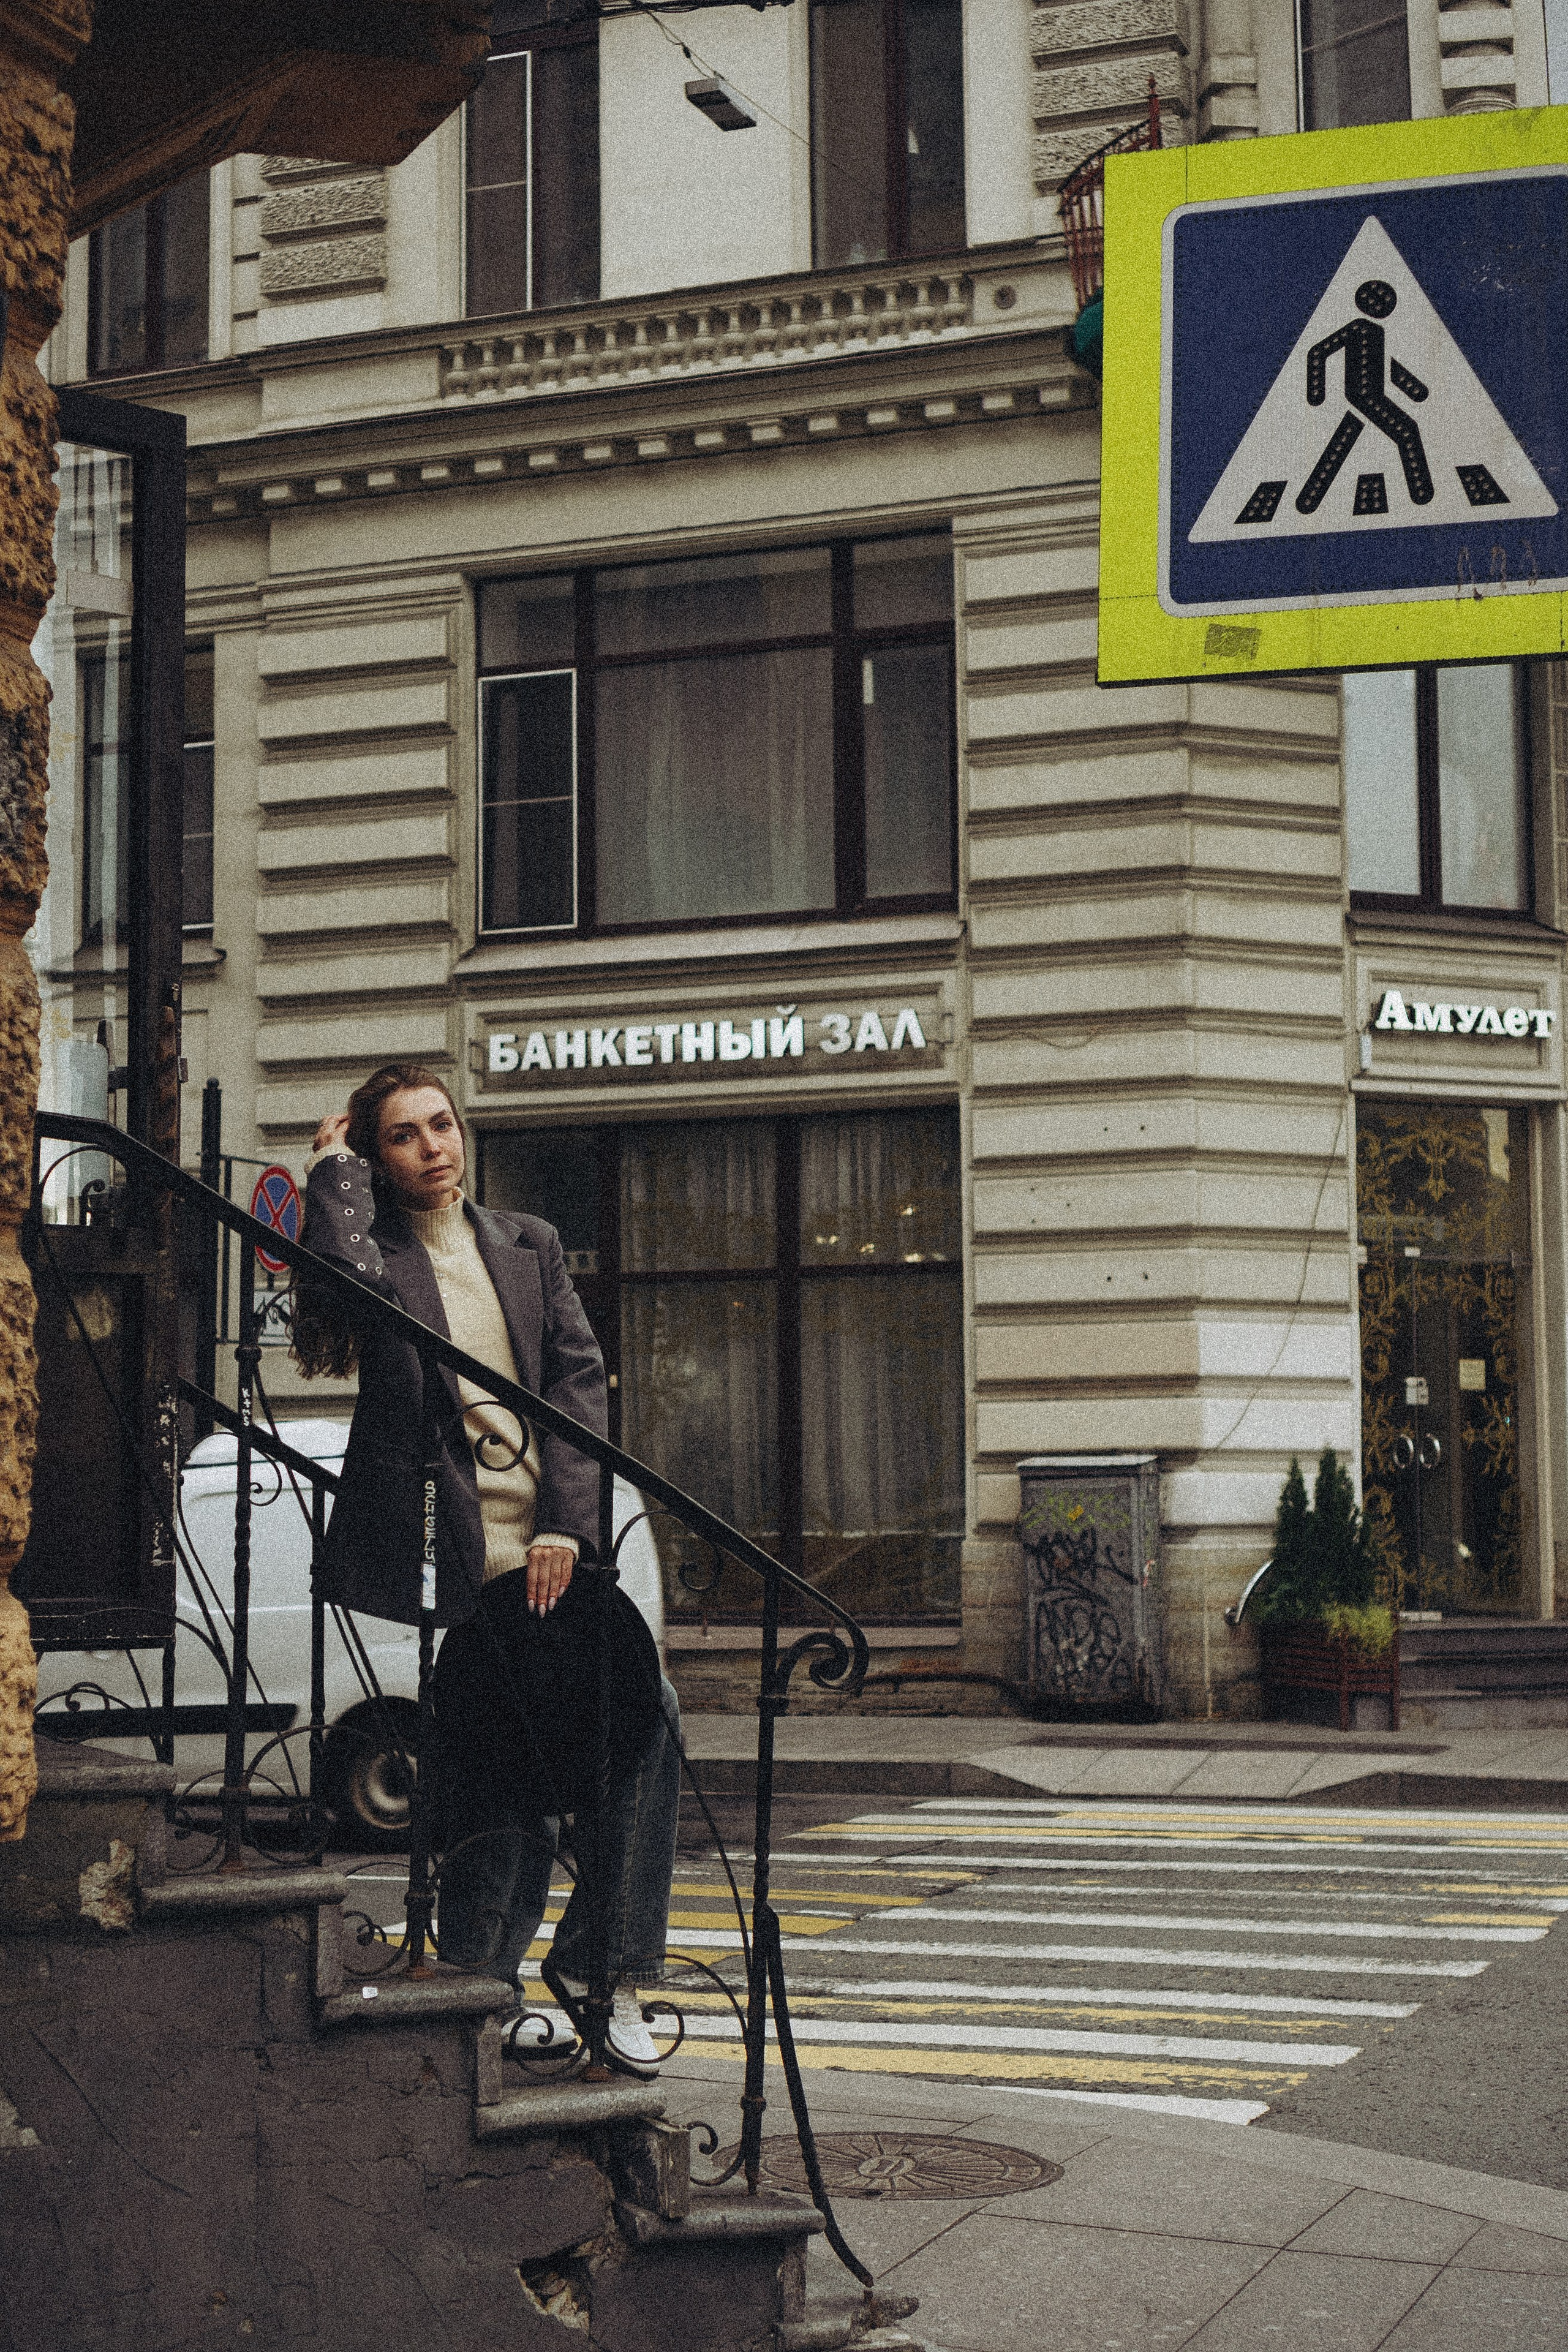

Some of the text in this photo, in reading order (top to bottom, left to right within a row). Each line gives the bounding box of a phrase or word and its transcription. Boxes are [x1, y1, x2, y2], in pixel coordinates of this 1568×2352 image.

[489, 1005, 925, 1073] БАНКЕТНЫЙ ЗАЛ
[1375, 989, 1556, 1038] Амулет
